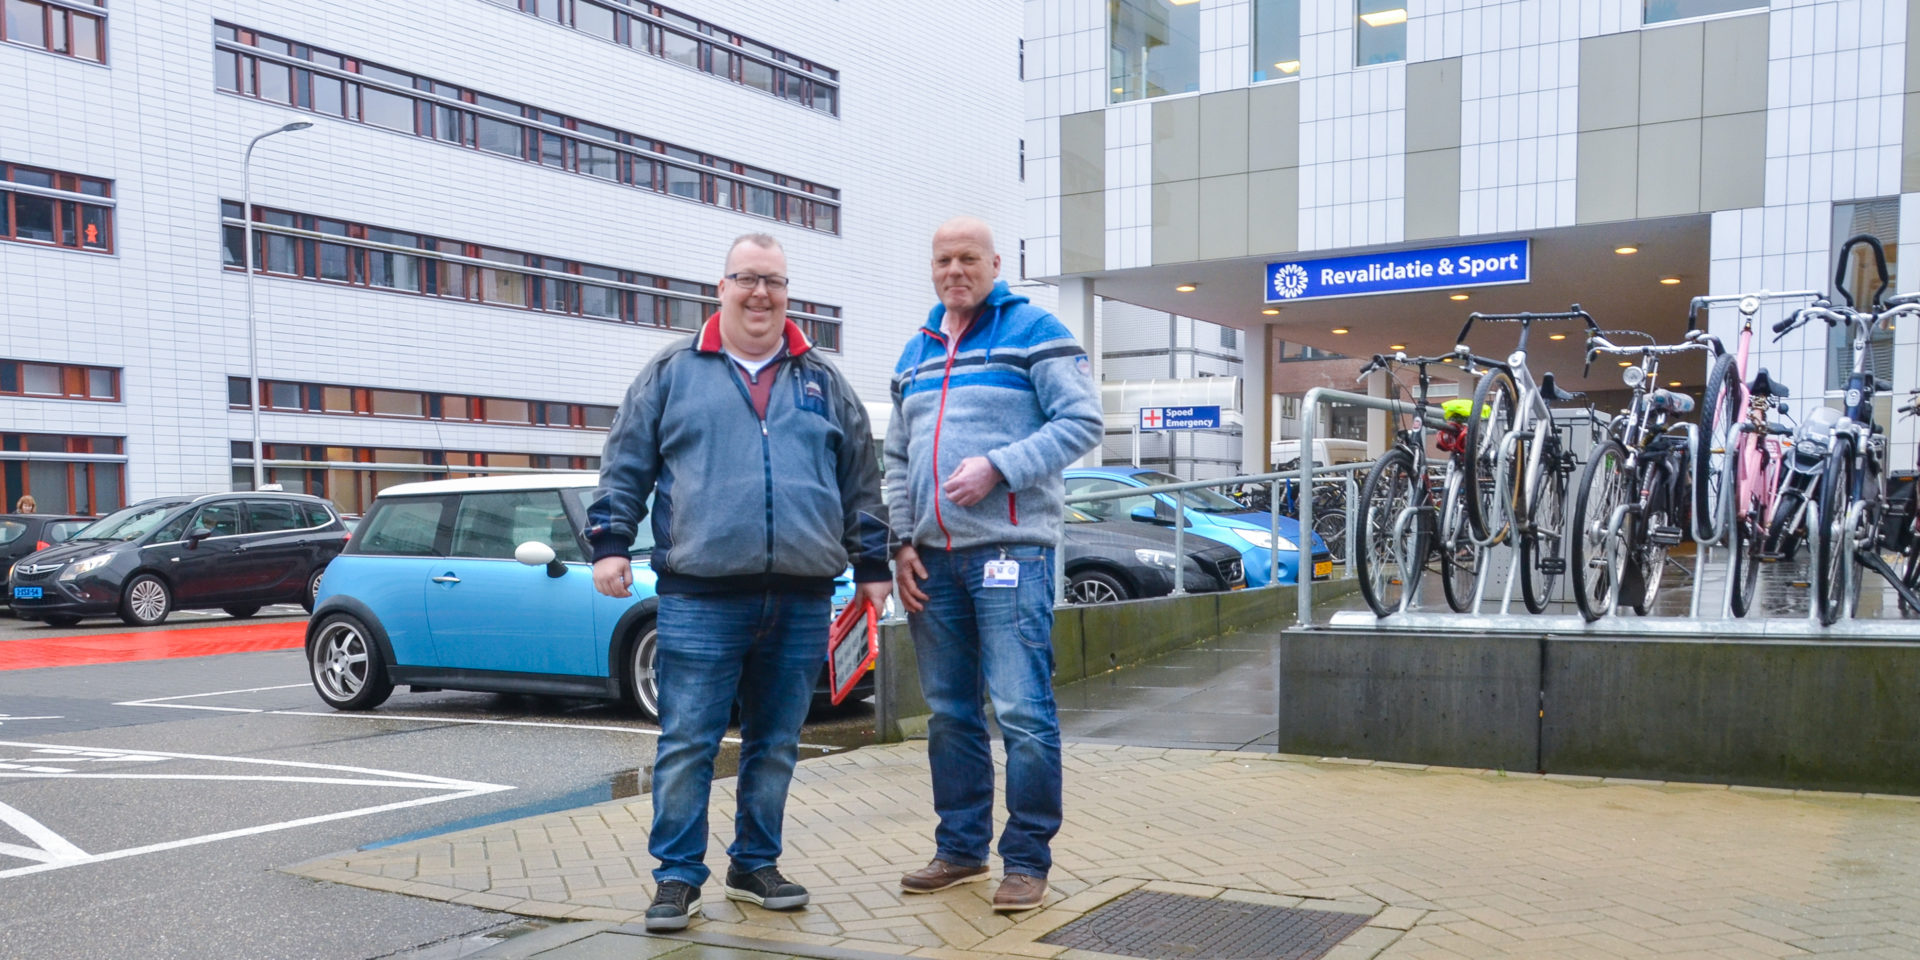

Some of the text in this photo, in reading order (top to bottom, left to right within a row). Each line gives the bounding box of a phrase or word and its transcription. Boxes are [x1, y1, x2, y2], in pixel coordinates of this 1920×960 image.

[1321, 253, 1518, 285] Revalidatie & Sport
[1166, 408, 1193, 418] Spoed
[1166, 419, 1213, 428] Emergency
